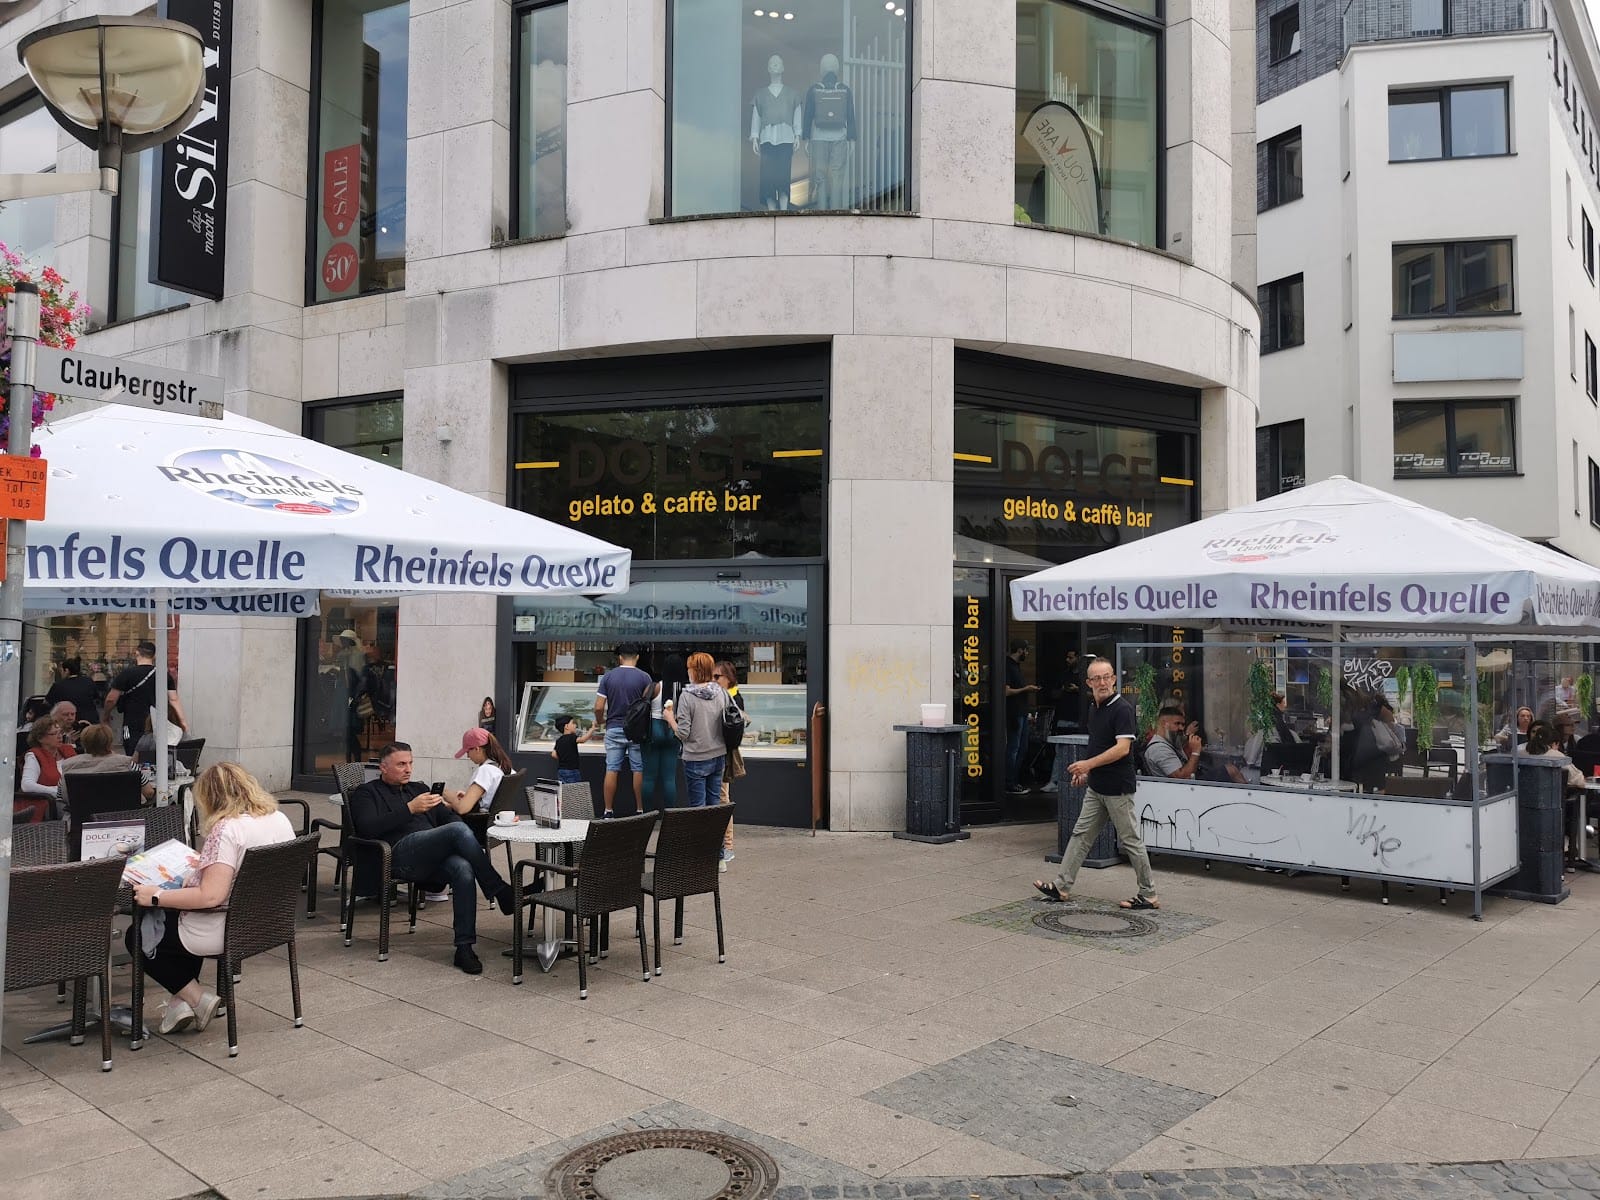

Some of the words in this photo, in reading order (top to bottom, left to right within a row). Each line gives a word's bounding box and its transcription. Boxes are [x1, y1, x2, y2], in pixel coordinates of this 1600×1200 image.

[332, 155, 349, 216] SALE
[187, 207, 202, 234] das
[201, 212, 215, 256] macht
[60, 357, 203, 406] Claubergstr.
[25, 470, 45, 481] 100
[569, 433, 763, 488] DOLCE
[1002, 439, 1154, 499] DOLCE
[1413, 457, 1445, 467] JOB
[1479, 456, 1512, 466] JOB
[156, 464, 364, 496] Rheinfels
[246, 485, 314, 499] Quelle
[568, 495, 635, 522] gelato
[640, 492, 657, 514] &
[663, 490, 717, 513] caffè
[724, 490, 762, 511] bar
[1003, 495, 1059, 521] gelato
[1063, 501, 1077, 522] &
[1081, 503, 1122, 527] caffè
[1126, 506, 1153, 528] bar
[1203, 532, 1339, 549] Rheinfels
[158, 536, 306, 584] Quelle
[353, 543, 514, 587] Rheinfels
[520, 553, 617, 589] Quelle
[964, 594, 979, 629] bar
[1022, 584, 1129, 612] Rheinfels
[1134, 583, 1218, 612] Quelle
[1250, 581, 1392, 614] Rheinfels
[1400, 582, 1511, 616] Quelle
[964, 635, 979, 686] caffè
[964, 691, 979, 707] &
[964, 713, 982, 778] gelato
[85, 833, 111, 841] DOLCE
